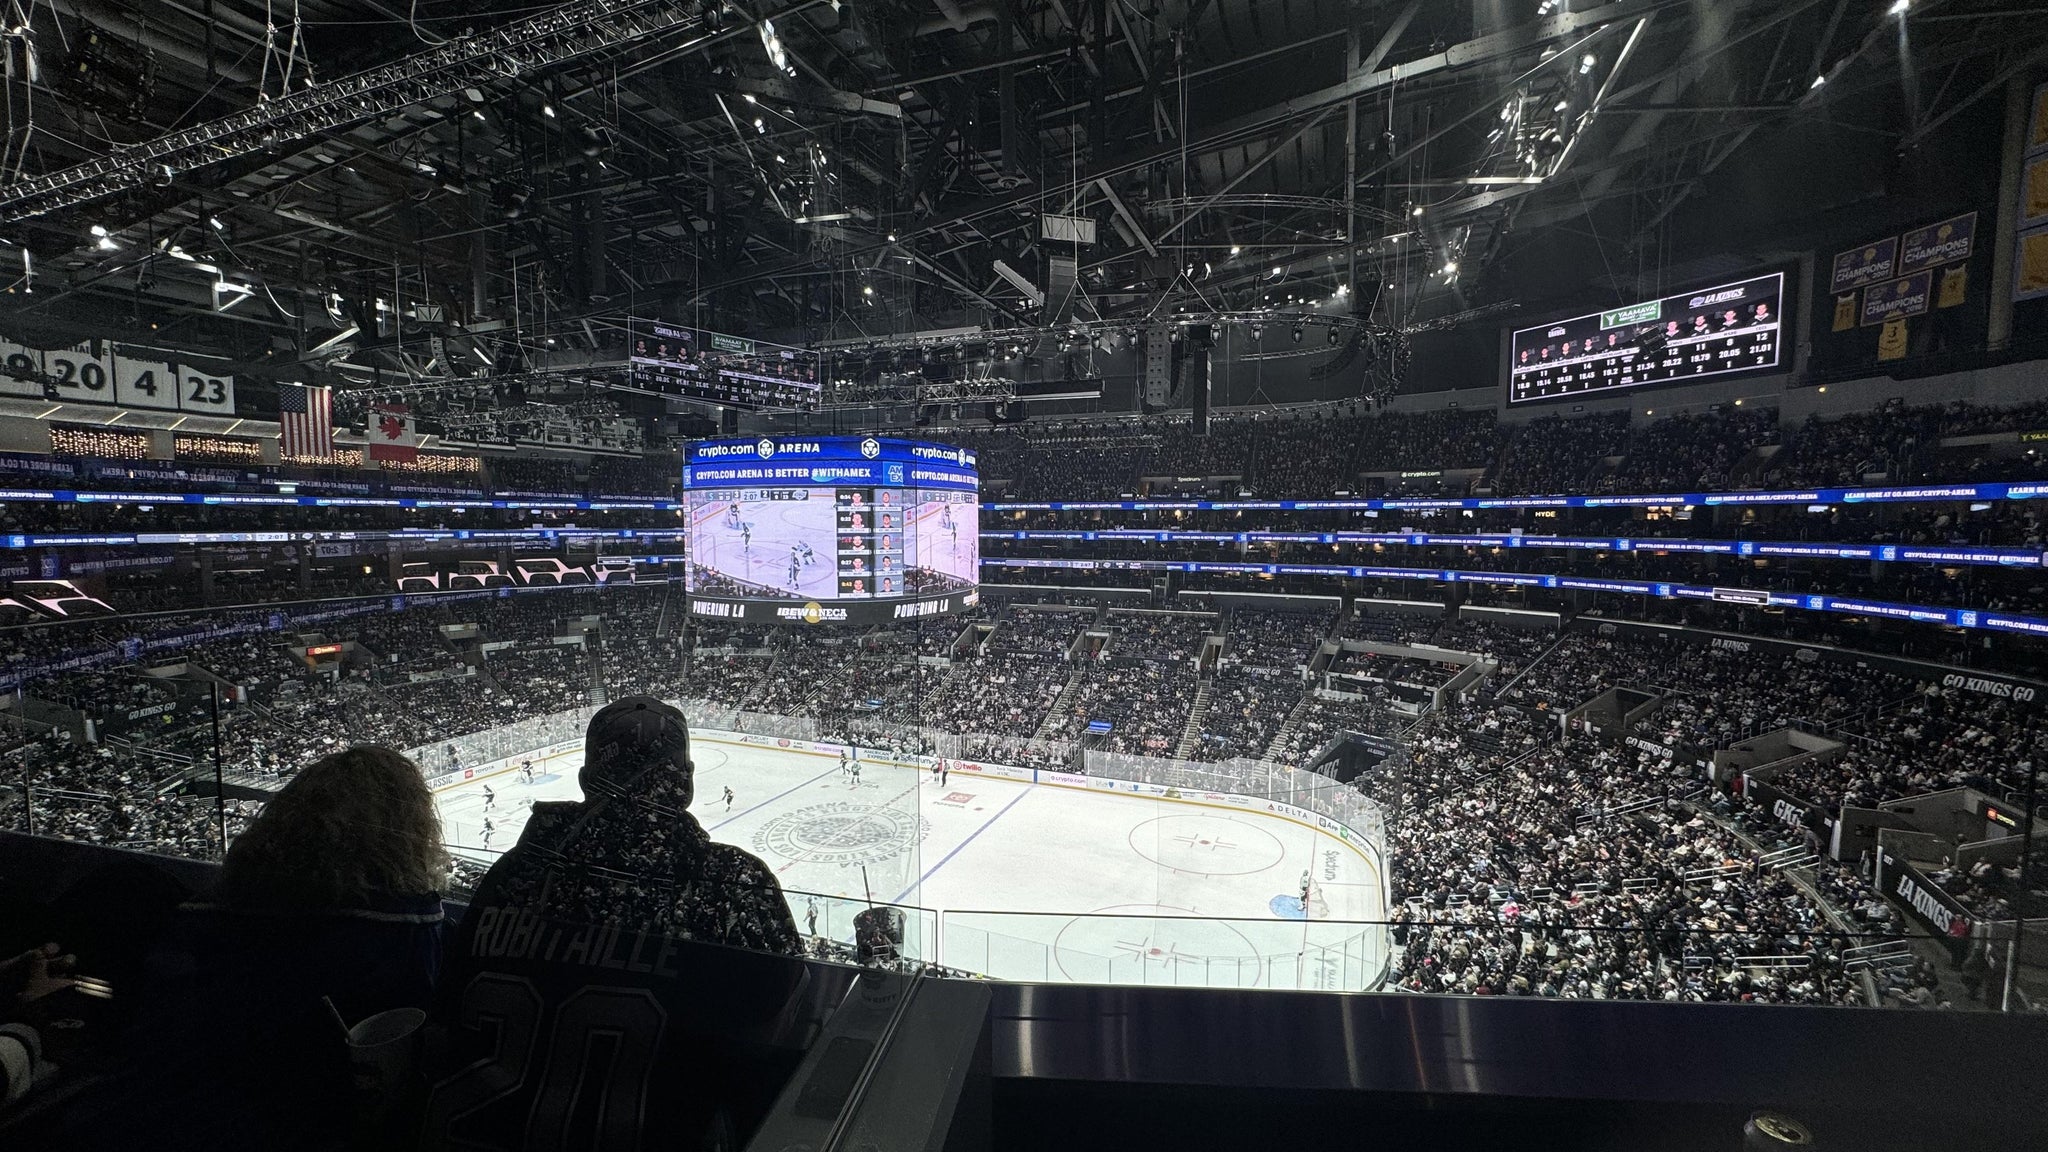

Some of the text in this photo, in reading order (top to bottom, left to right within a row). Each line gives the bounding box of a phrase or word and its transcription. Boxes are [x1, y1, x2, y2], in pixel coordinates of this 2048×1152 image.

[1904, 238, 1968, 263] CHAMPIONS
[1836, 260, 1891, 282] CHAMPIONS
[1866, 294, 1924, 316] CHAMPIONS
[1756, 333, 1768, 341] 12
[1749, 344, 1772, 354] 21.01
[54, 359, 106, 390] 20
[134, 370, 158, 397] 4
[188, 376, 226, 404] 23
[699, 443, 820, 458] crypto.com ARENA
[696, 468, 871, 480] CRYPTO.COM ARENA IS BETTER #WITHAMEX
[246, 532, 252, 541] 3
[693, 601, 745, 618] POWERING LA
[777, 608, 808, 616] IBEW
[818, 608, 847, 616] NECA
[940, 599, 948, 612] LA
[1831, 602, 1863, 610] CRYPTO.COM
[1987, 619, 2029, 629] CRYPTO.COM
[1711, 638, 1750, 651] LA KINGS
[1942, 674, 2034, 701] GO KINGS GO
[129, 702, 176, 720] GO KINGS GO
[1625, 736, 1674, 759] GO KINGS GO
[476, 765, 494, 774] TOYOTA
[962, 763, 982, 771] twilio
[1278, 806, 1308, 820] DELTA
[1324, 850, 1340, 881] Spectrum
[1896, 874, 1954, 933] LA KINGS
[418, 970, 668, 1152] 20
